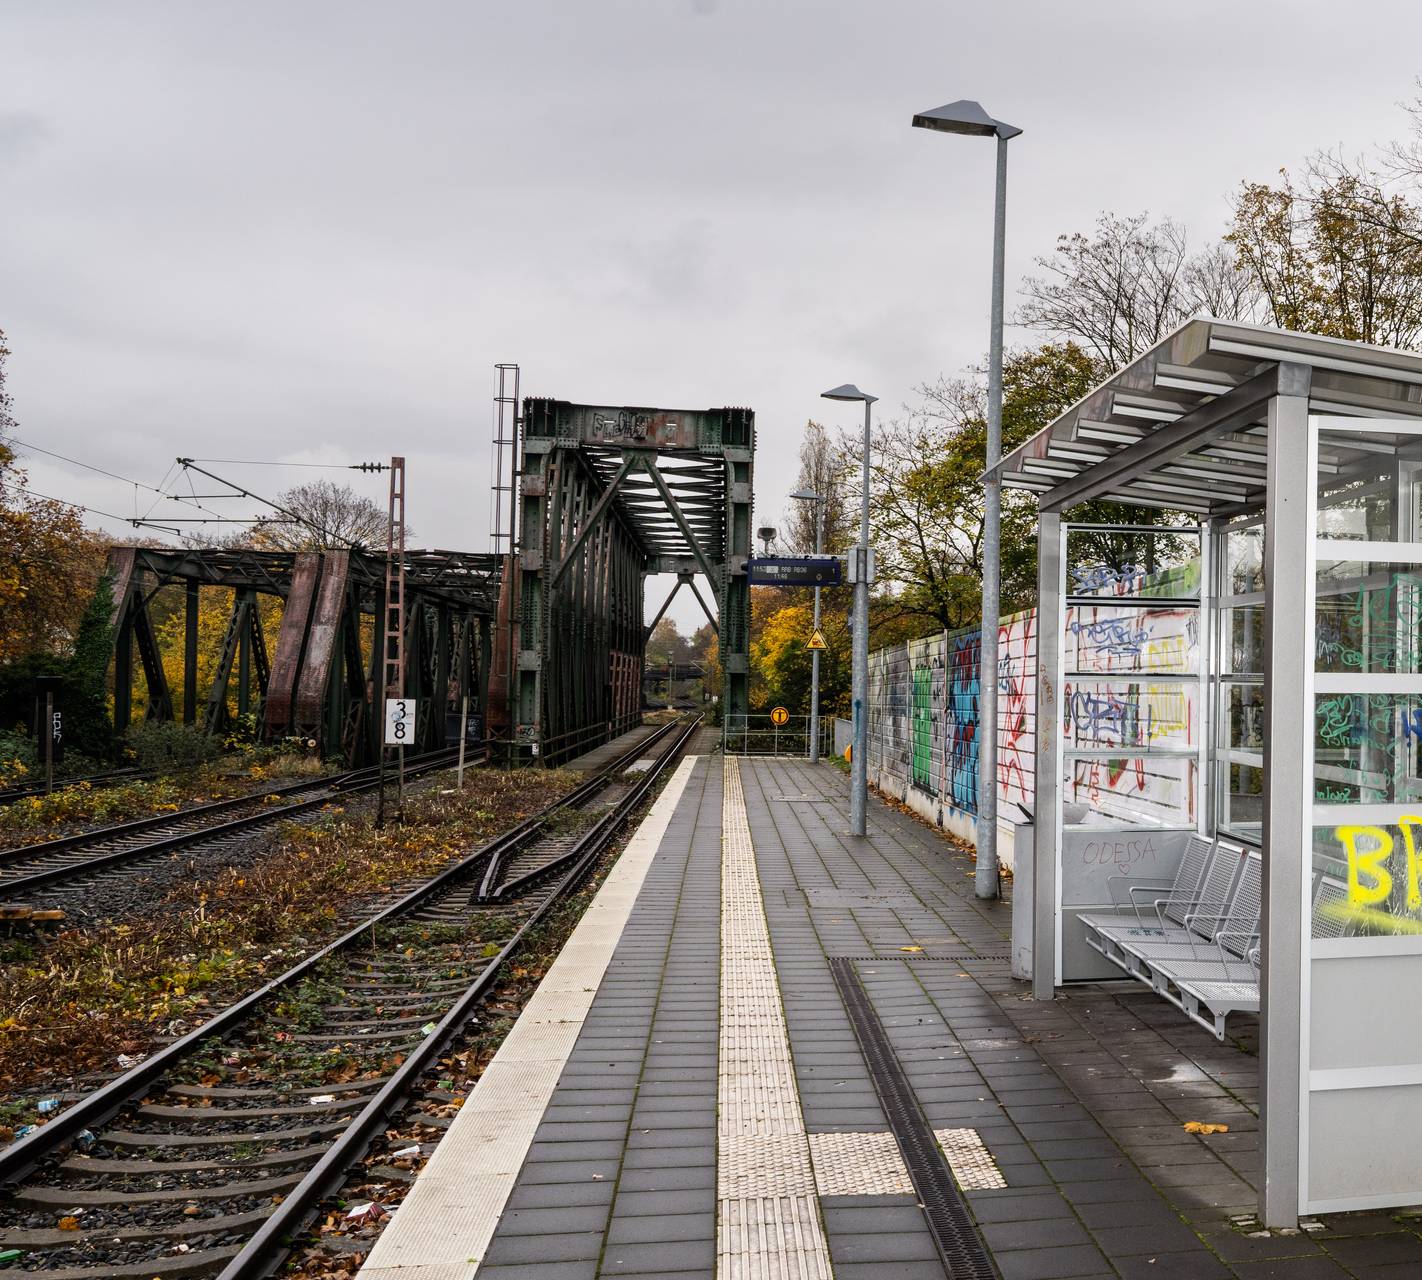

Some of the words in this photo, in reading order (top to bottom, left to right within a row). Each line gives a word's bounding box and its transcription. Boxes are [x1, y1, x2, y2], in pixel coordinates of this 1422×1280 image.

[396, 701, 407, 719] 3
[394, 722, 406, 739] 8
[1082, 838, 1159, 865] ODESSA
